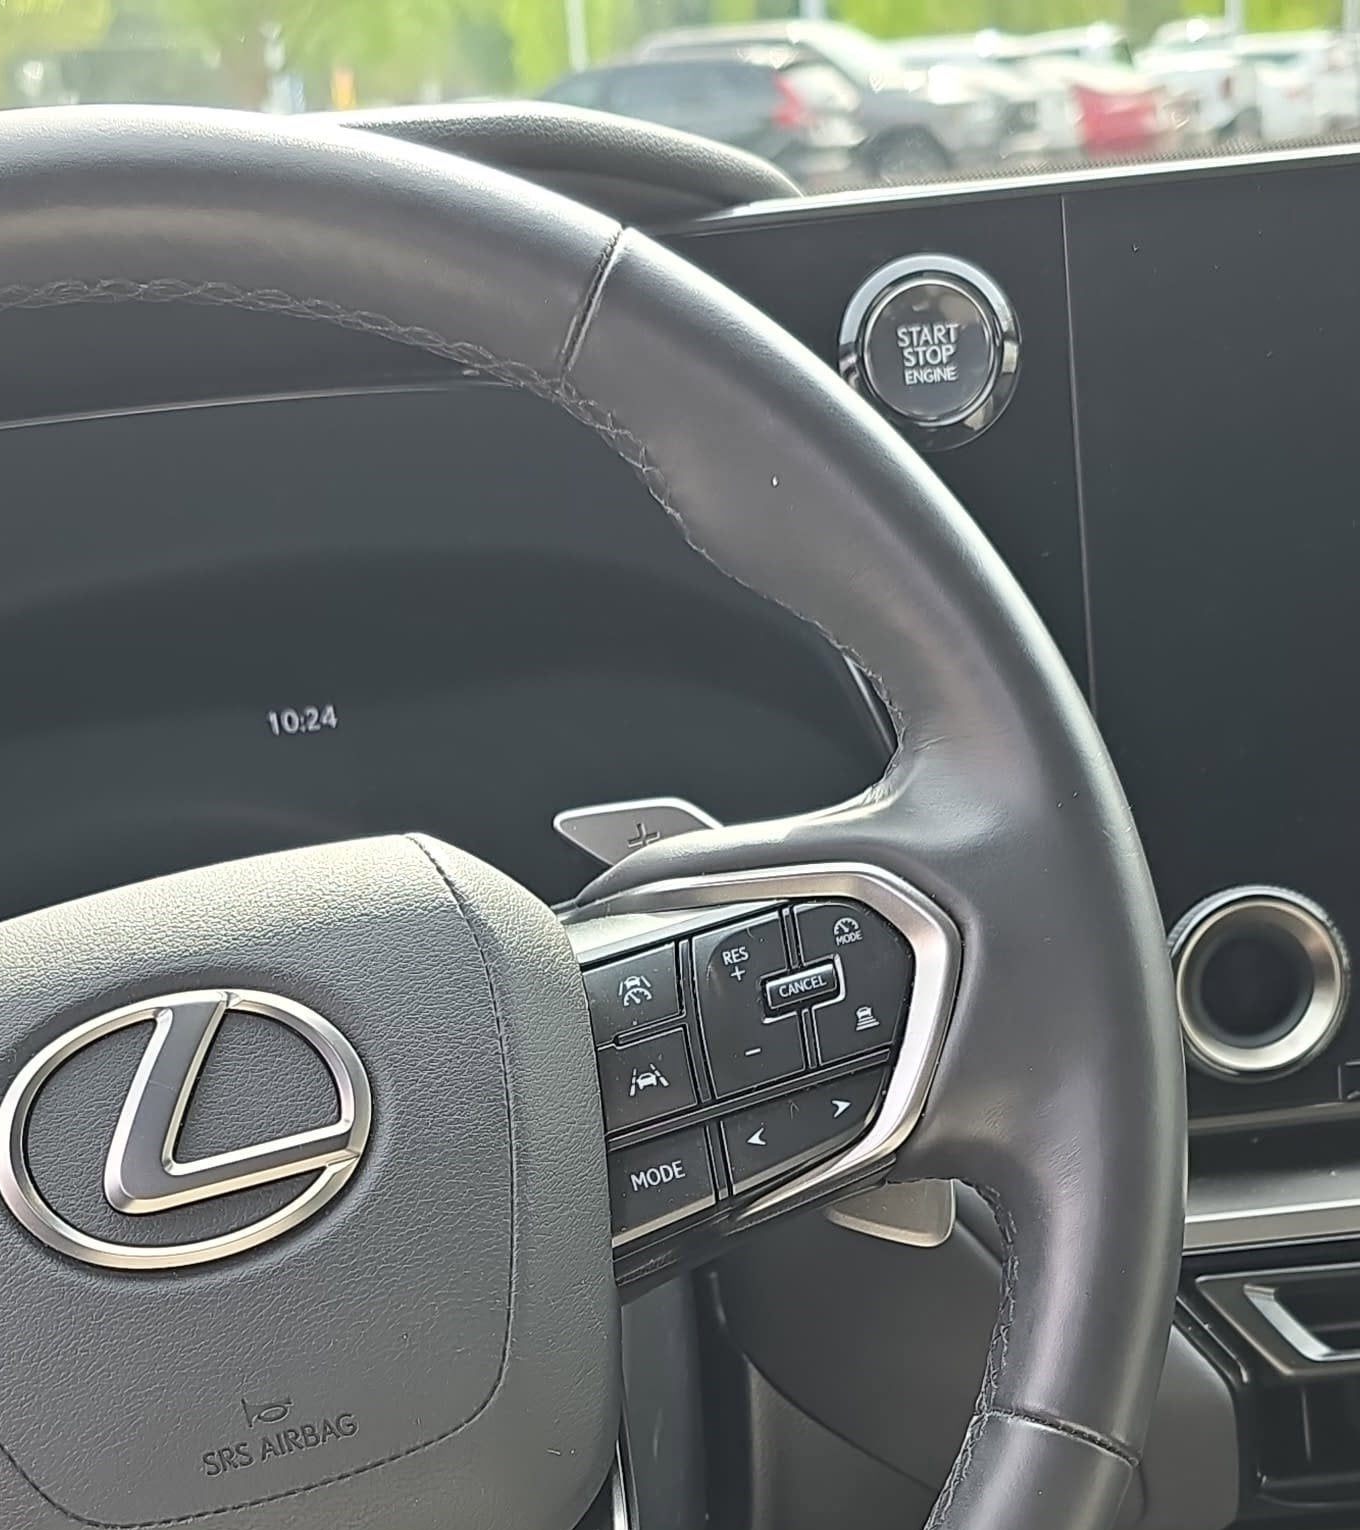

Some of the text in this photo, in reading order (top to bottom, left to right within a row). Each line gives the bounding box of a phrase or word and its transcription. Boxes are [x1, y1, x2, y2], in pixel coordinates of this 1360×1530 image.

[896, 322, 960, 347] START
[903, 343, 955, 367] STOP
[904, 365, 958, 385] ENGINE
[268, 704, 339, 736] 10:24
[836, 930, 863, 946] MODE
[722, 946, 749, 965] RES
[778, 975, 827, 998] CANCEL
[630, 1160, 686, 1191] MODE
[202, 1412, 359, 1477] SRS AIRBAG
